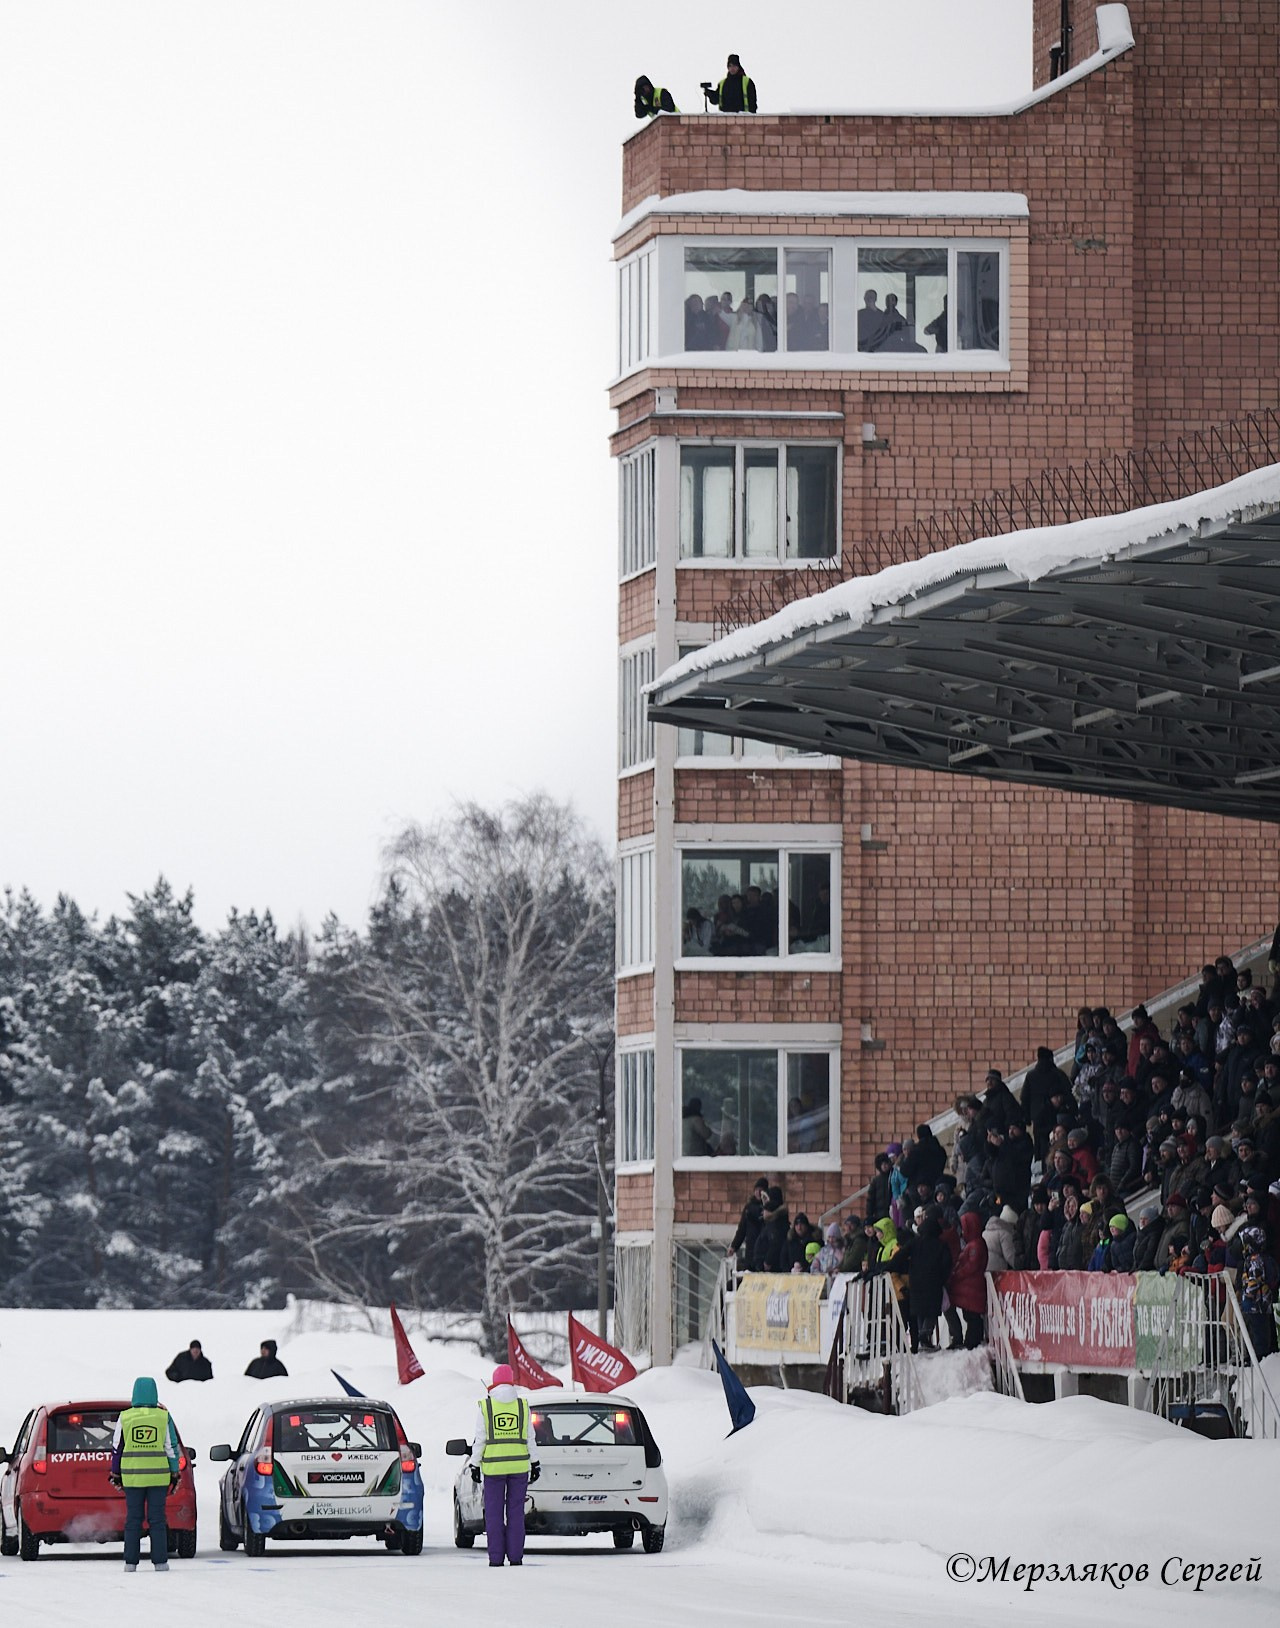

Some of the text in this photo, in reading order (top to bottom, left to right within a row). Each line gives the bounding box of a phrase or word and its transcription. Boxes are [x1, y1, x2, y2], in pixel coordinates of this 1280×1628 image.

[1090, 1286, 1134, 1348] РУБЛЕЙ
[322, 1474, 363, 1482] YOKOHAMA
[316, 1504, 372, 1516] КУЗНЕЦКИЙ
